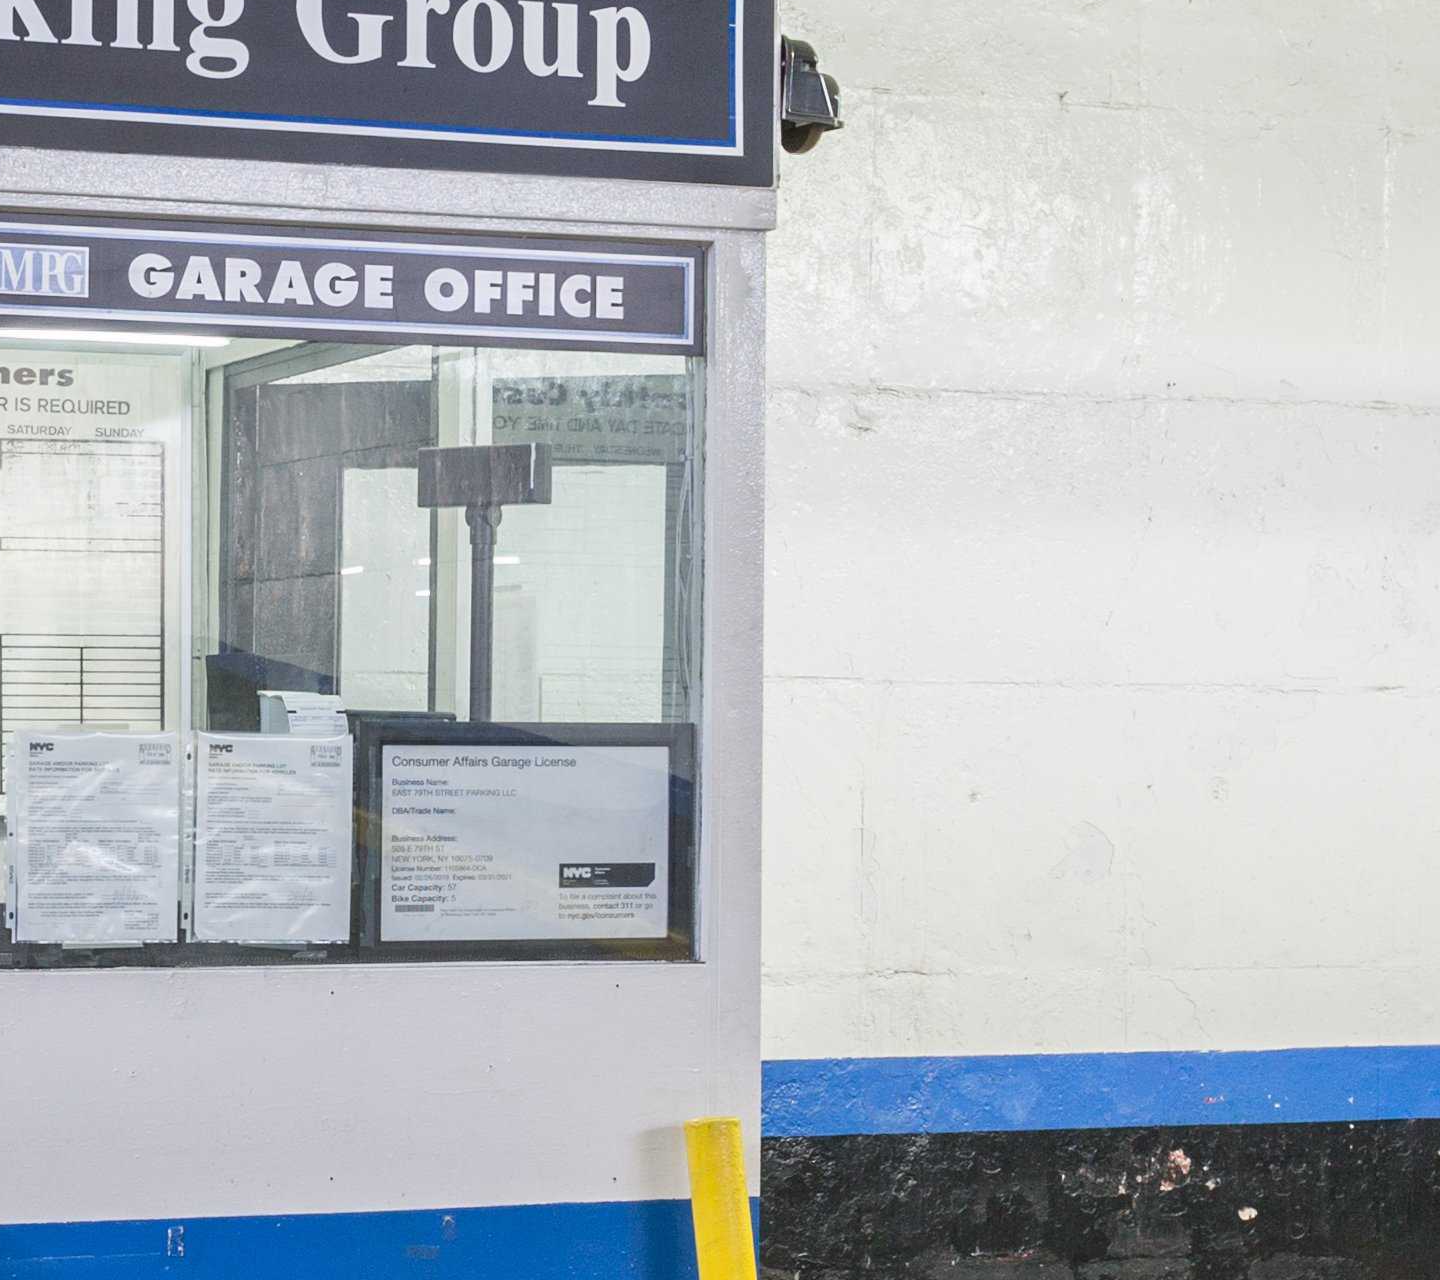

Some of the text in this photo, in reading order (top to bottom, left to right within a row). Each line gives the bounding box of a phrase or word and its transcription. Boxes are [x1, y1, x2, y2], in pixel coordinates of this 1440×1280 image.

[128, 253, 395, 310] GARAGE
[424, 266, 625, 320] OFFICE
[15, 396, 31, 412] IS
[37, 398, 130, 416] REQUIRED
[7, 424, 72, 437] SATURDAY
[95, 427, 144, 439] SUNDAY
[29, 742, 54, 751] NYC
[392, 756, 576, 770] Consumer Affairs Garage License
[392, 778, 425, 786] Business
[563, 867, 592, 878] NYC
